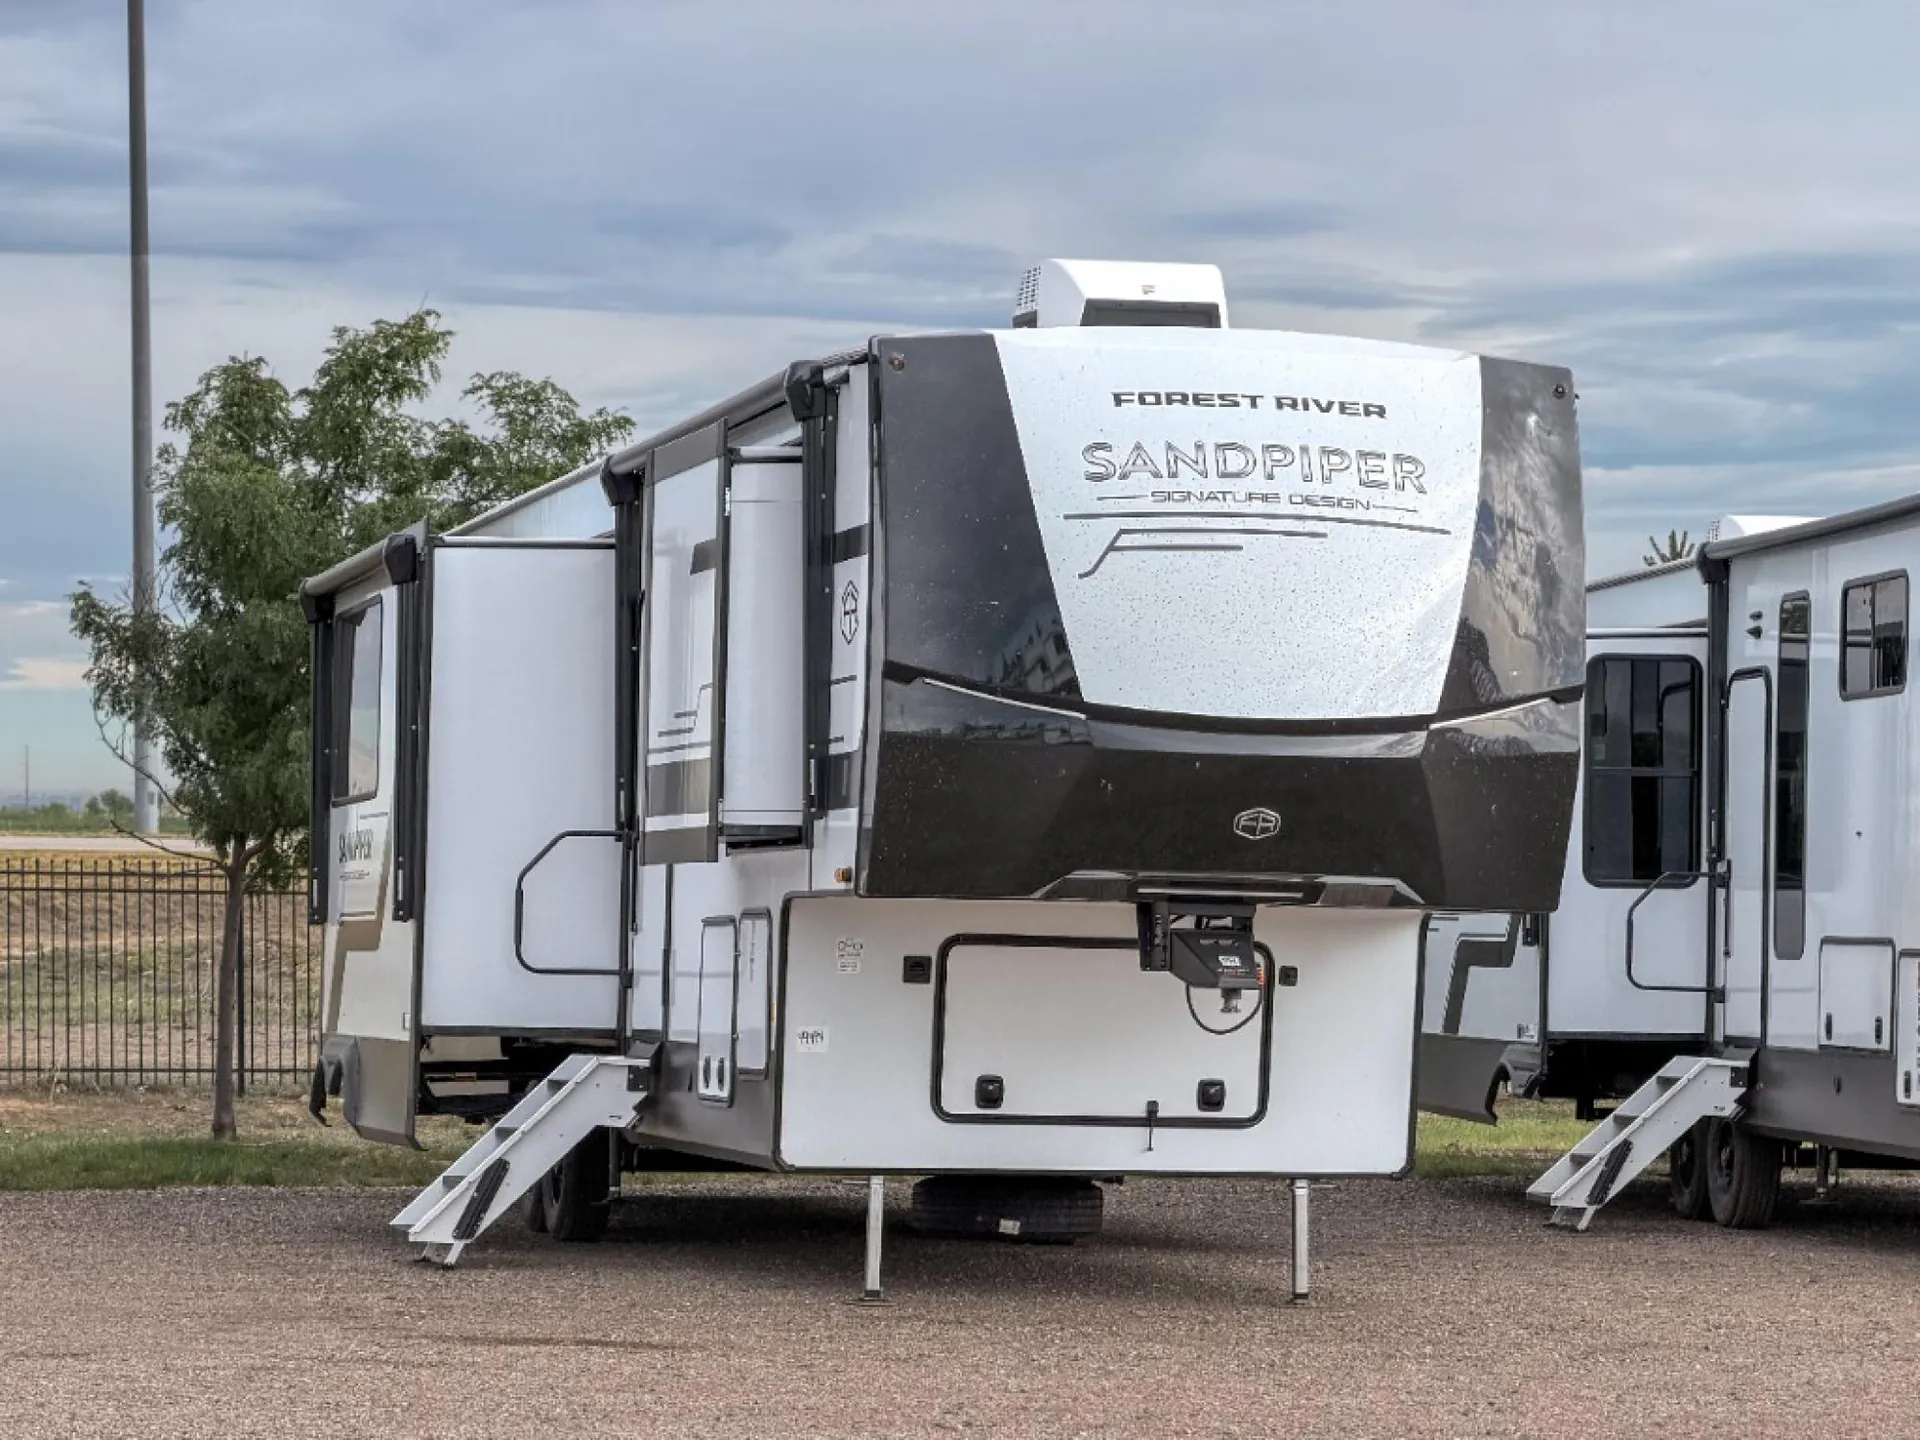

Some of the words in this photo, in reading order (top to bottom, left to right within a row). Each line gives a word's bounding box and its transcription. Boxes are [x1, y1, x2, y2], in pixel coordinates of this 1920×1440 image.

[1111, 391, 1264, 410] FOREST
[1274, 396, 1387, 418] RIVER
[1081, 440, 1428, 495] SANDPIPER
[1150, 490, 1281, 504] SIGNATURE
[1289, 493, 1371, 511] DESIGN
